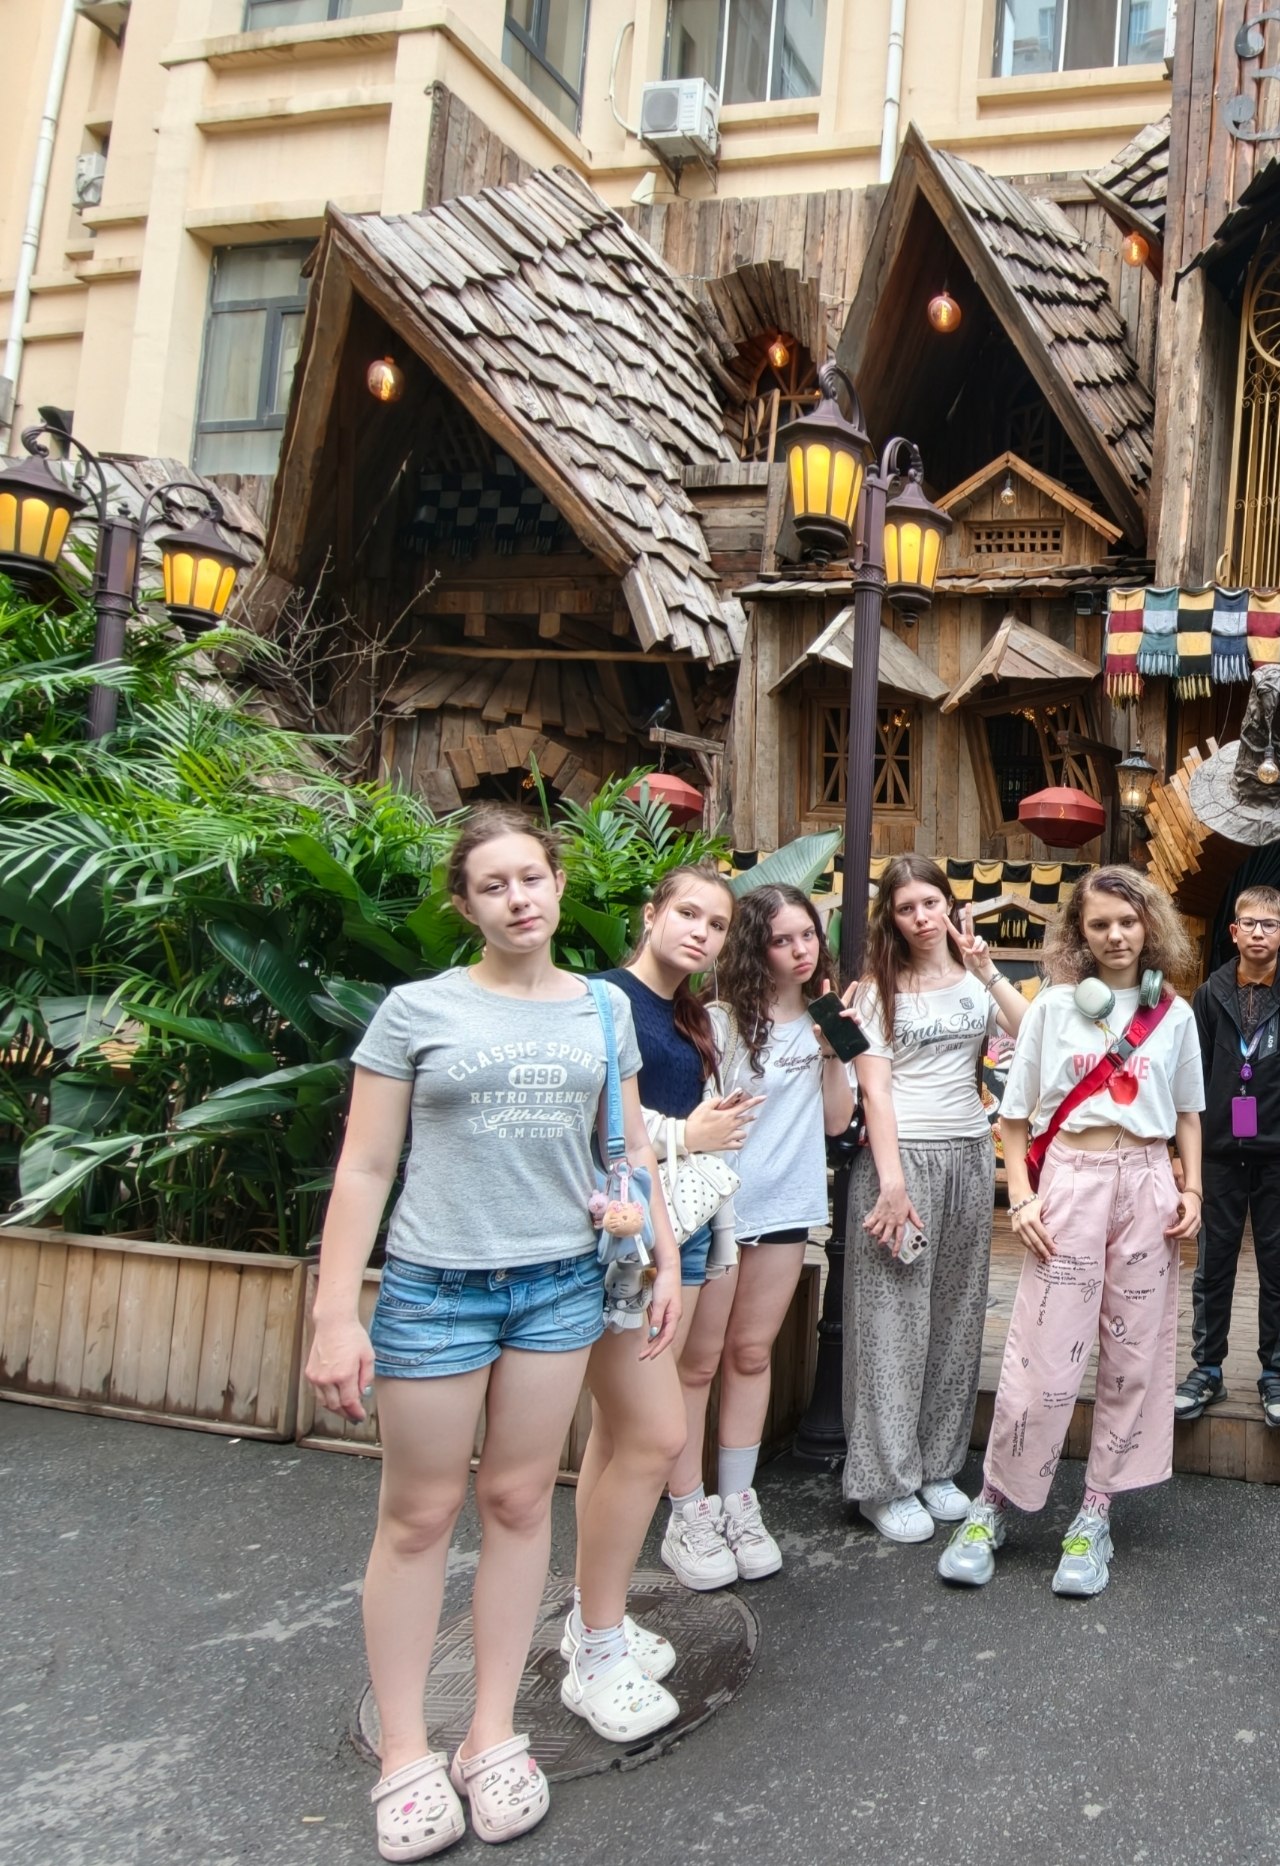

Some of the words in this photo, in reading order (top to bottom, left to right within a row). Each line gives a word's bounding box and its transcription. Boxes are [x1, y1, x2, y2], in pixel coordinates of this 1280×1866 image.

[447, 1041, 538, 1082] CLASSIC
[546, 1041, 605, 1081] SPORTS
[1073, 1053, 1150, 1080] POVE
[512, 1068, 562, 1085] 1998
[470, 1091, 526, 1105] RETRO
[535, 1091, 589, 1104] TRENDS
[487, 1107, 574, 1125] Athletic
[530, 1127, 563, 1138] CLUB
